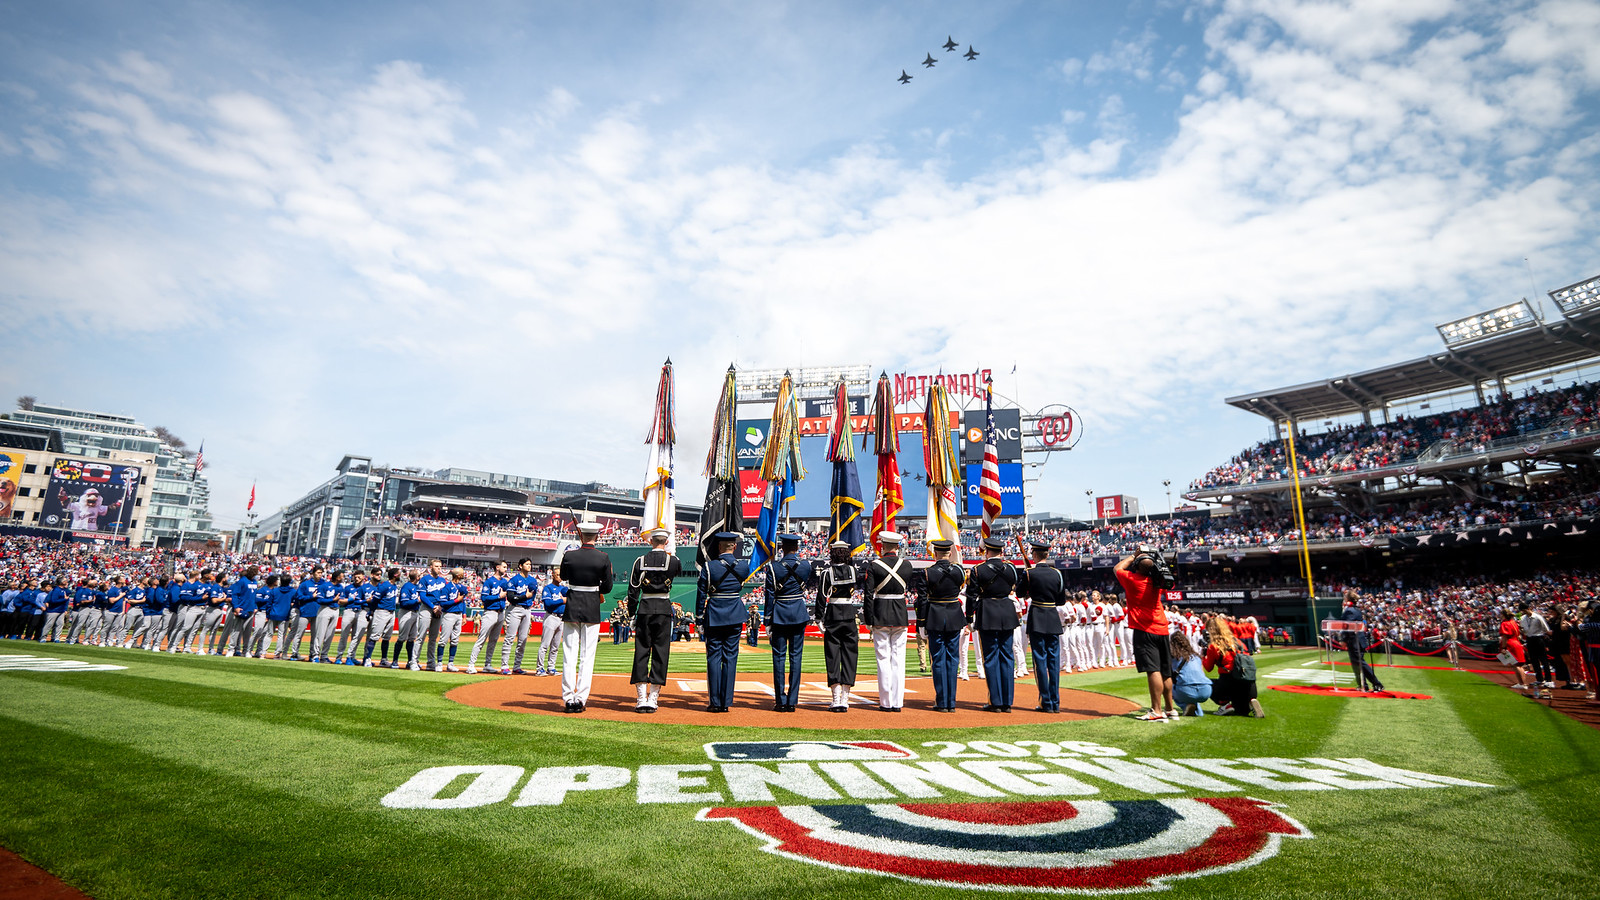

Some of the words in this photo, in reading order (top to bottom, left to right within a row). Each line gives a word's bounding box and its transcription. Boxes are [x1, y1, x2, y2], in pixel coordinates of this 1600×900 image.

[894, 369, 992, 404] NATIONALS
[492, 537, 503, 545] FOR
[922, 740, 1127, 758] 2026
[381, 759, 1100, 809] OPENING
[1081, 757, 1496, 794] WEEK
